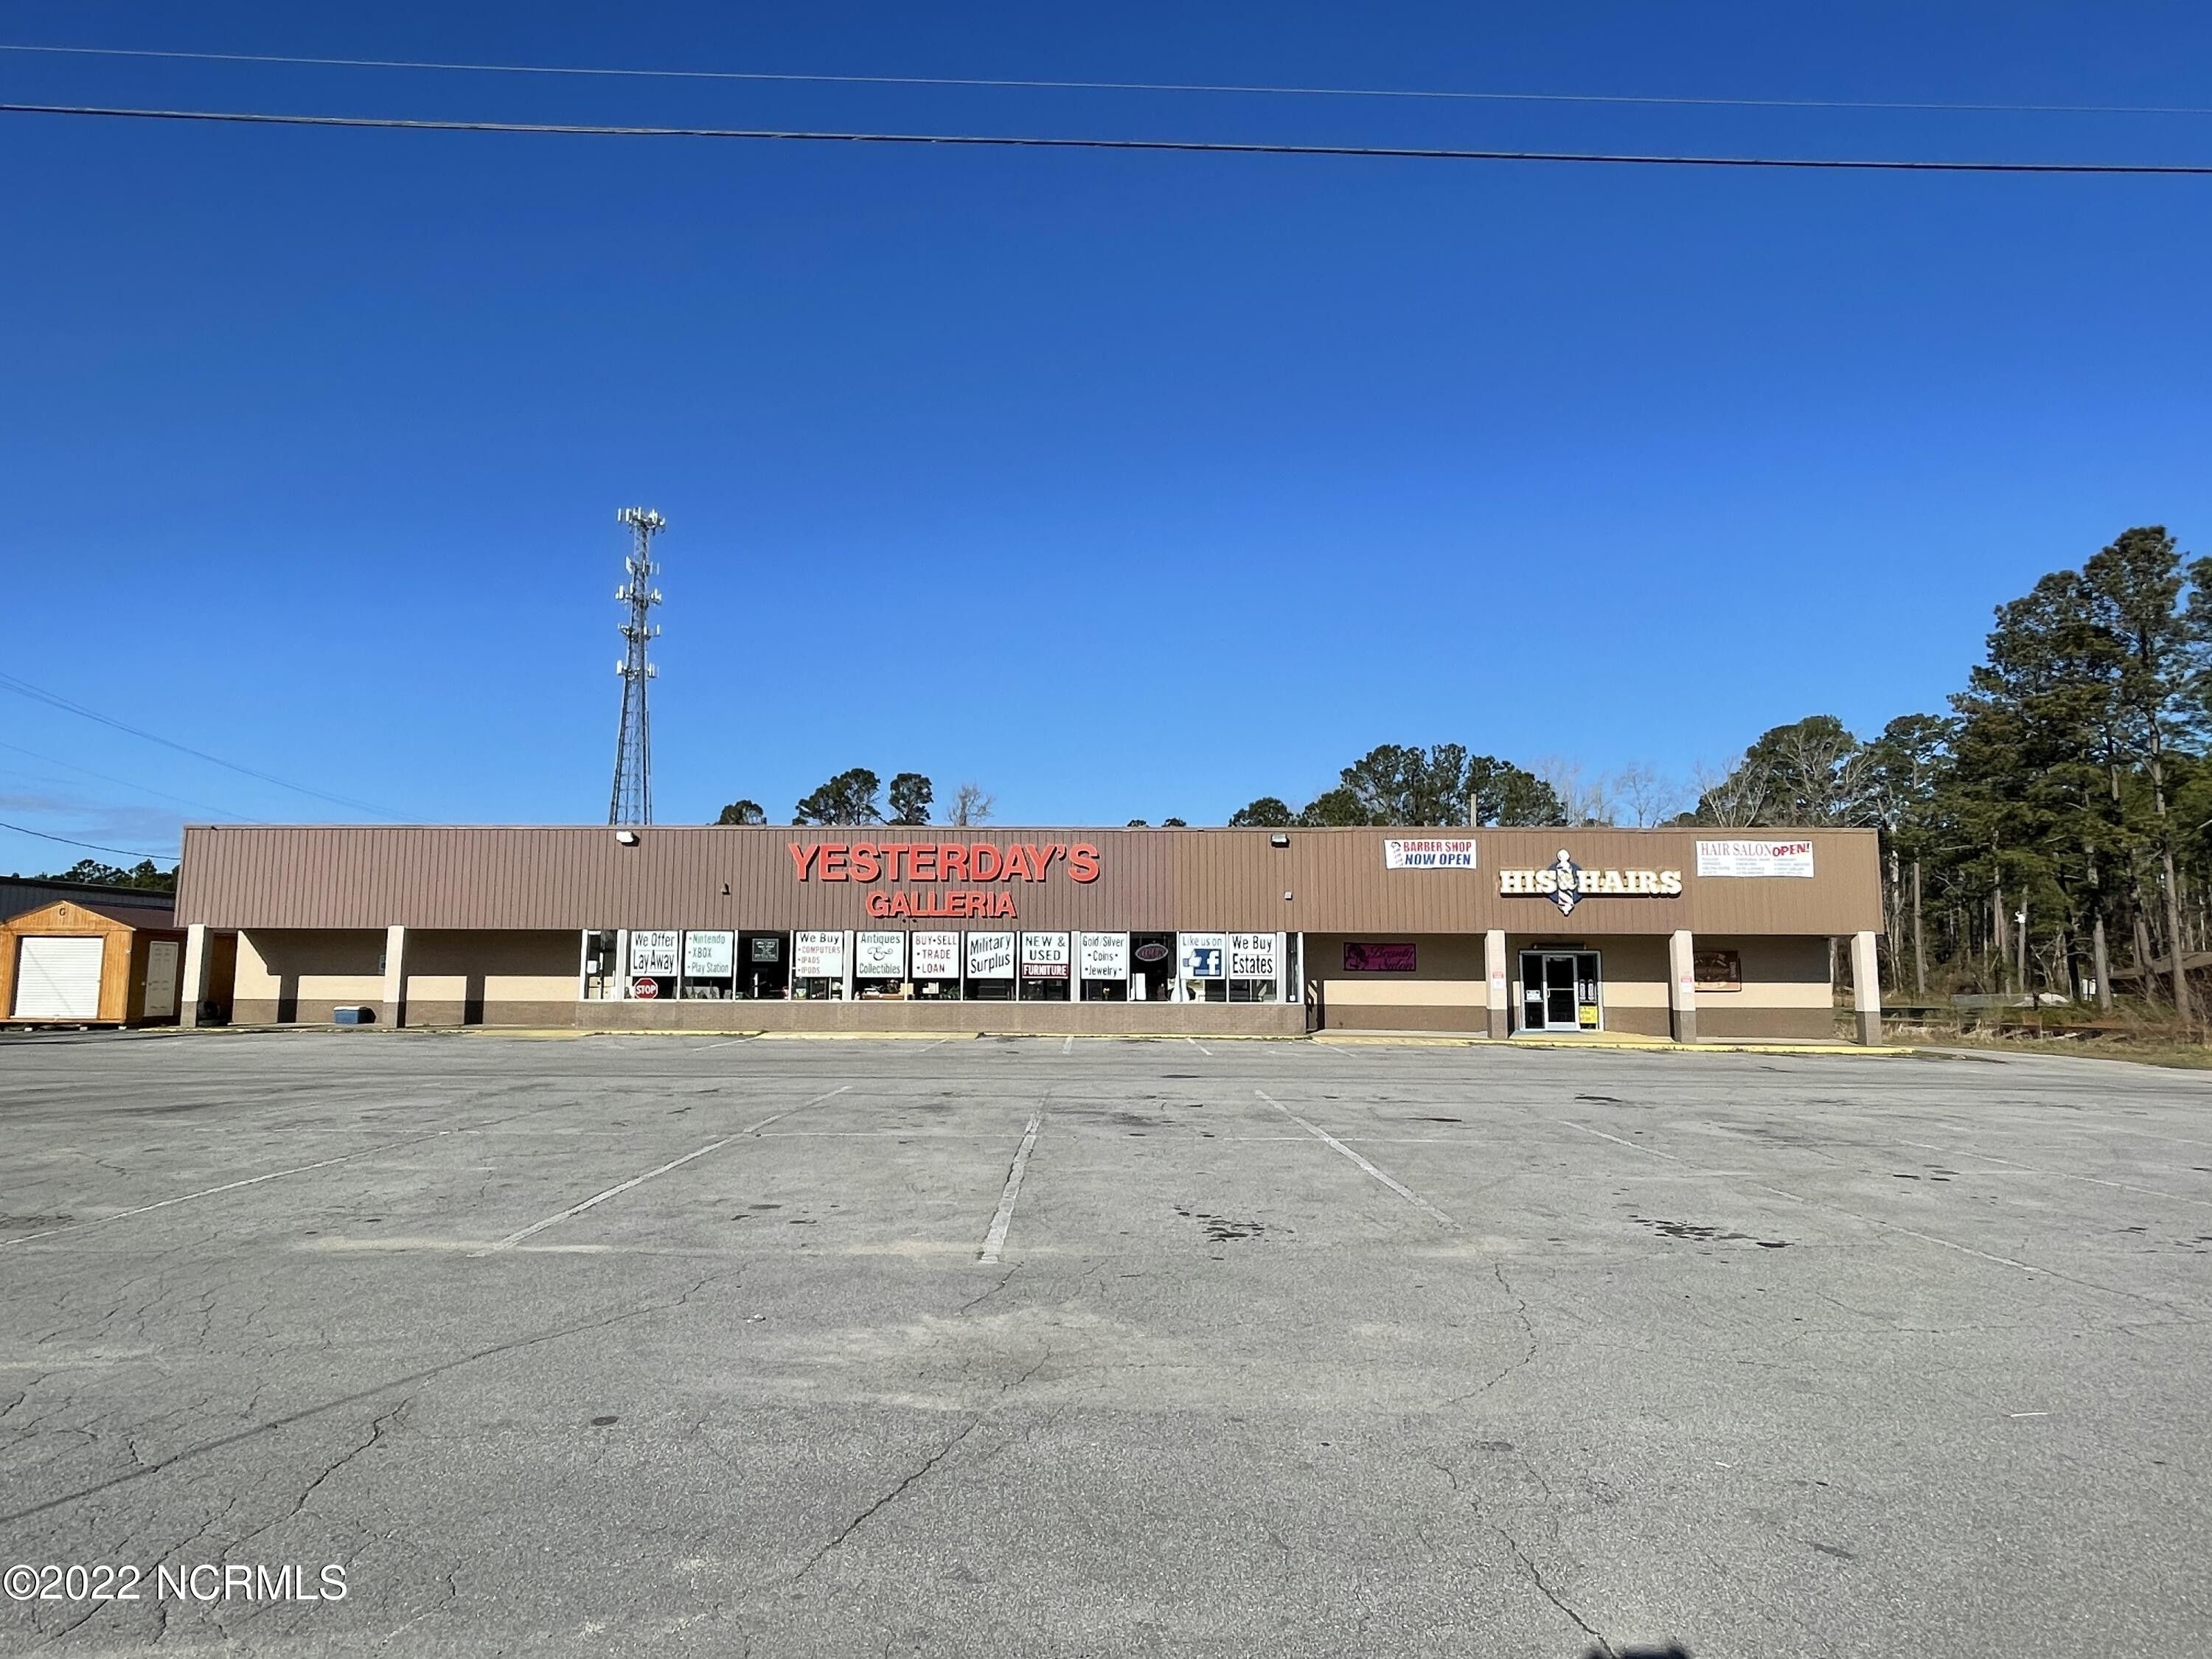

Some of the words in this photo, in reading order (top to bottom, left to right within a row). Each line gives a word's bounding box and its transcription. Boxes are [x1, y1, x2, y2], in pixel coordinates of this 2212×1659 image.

[1403, 841, 1442, 852] BARBER
[1445, 841, 1472, 852] SHOP
[1700, 843, 1730, 856] HAIR
[1733, 843, 1771, 856] SALON
[1772, 843, 1810, 858] OPEN!
[788, 843, 1100, 883] YESTERDAY'S
[1405, 854, 1436, 865] NOW
[1439, 854, 1471, 865] OPEN
[1499, 869, 1557, 894] HIS
[1576, 869, 1683, 894] HAIRS
[866, 890, 1018, 919] GALLERIA
[635, 933, 649, 947] We
[651, 933, 675, 947] Offer
[692, 933, 726, 945] Nintendo
[800, 933, 816, 943] We
[819, 933, 839, 945] Buy
[860, 932, 901, 945] Antiques
[1026, 936, 1052, 947] NEW
[1057, 936, 1066, 947] &
[1183, 935, 1200, 946] Like
[1201, 937, 1210, 946] us
[1211, 937, 1222, 946] on
[1232, 936, 1248, 950] We
[1253, 936, 1273, 953] Buy
[802, 946, 841, 954] COMPUTERS
[970, 934, 1012, 956] Military
[692, 947, 712, 959] XBOX
[922, 949, 951, 959] TRADE
[1029, 950, 1061, 961] USED
[1093, 950, 1114, 961] Coins
[692, 962, 705, 975] Play
[706, 962, 728, 973] Station
[859, 963, 901, 974] Collectibles
[922, 963, 945, 973] LOAN
[970, 953, 1011, 974] Surplus
[1232, 953, 1273, 973] Estates
[1023, 964, 1068, 975] FURNITURE
[1089, 964, 1117, 978] Jewelry
[636, 985, 656, 995] STOP
